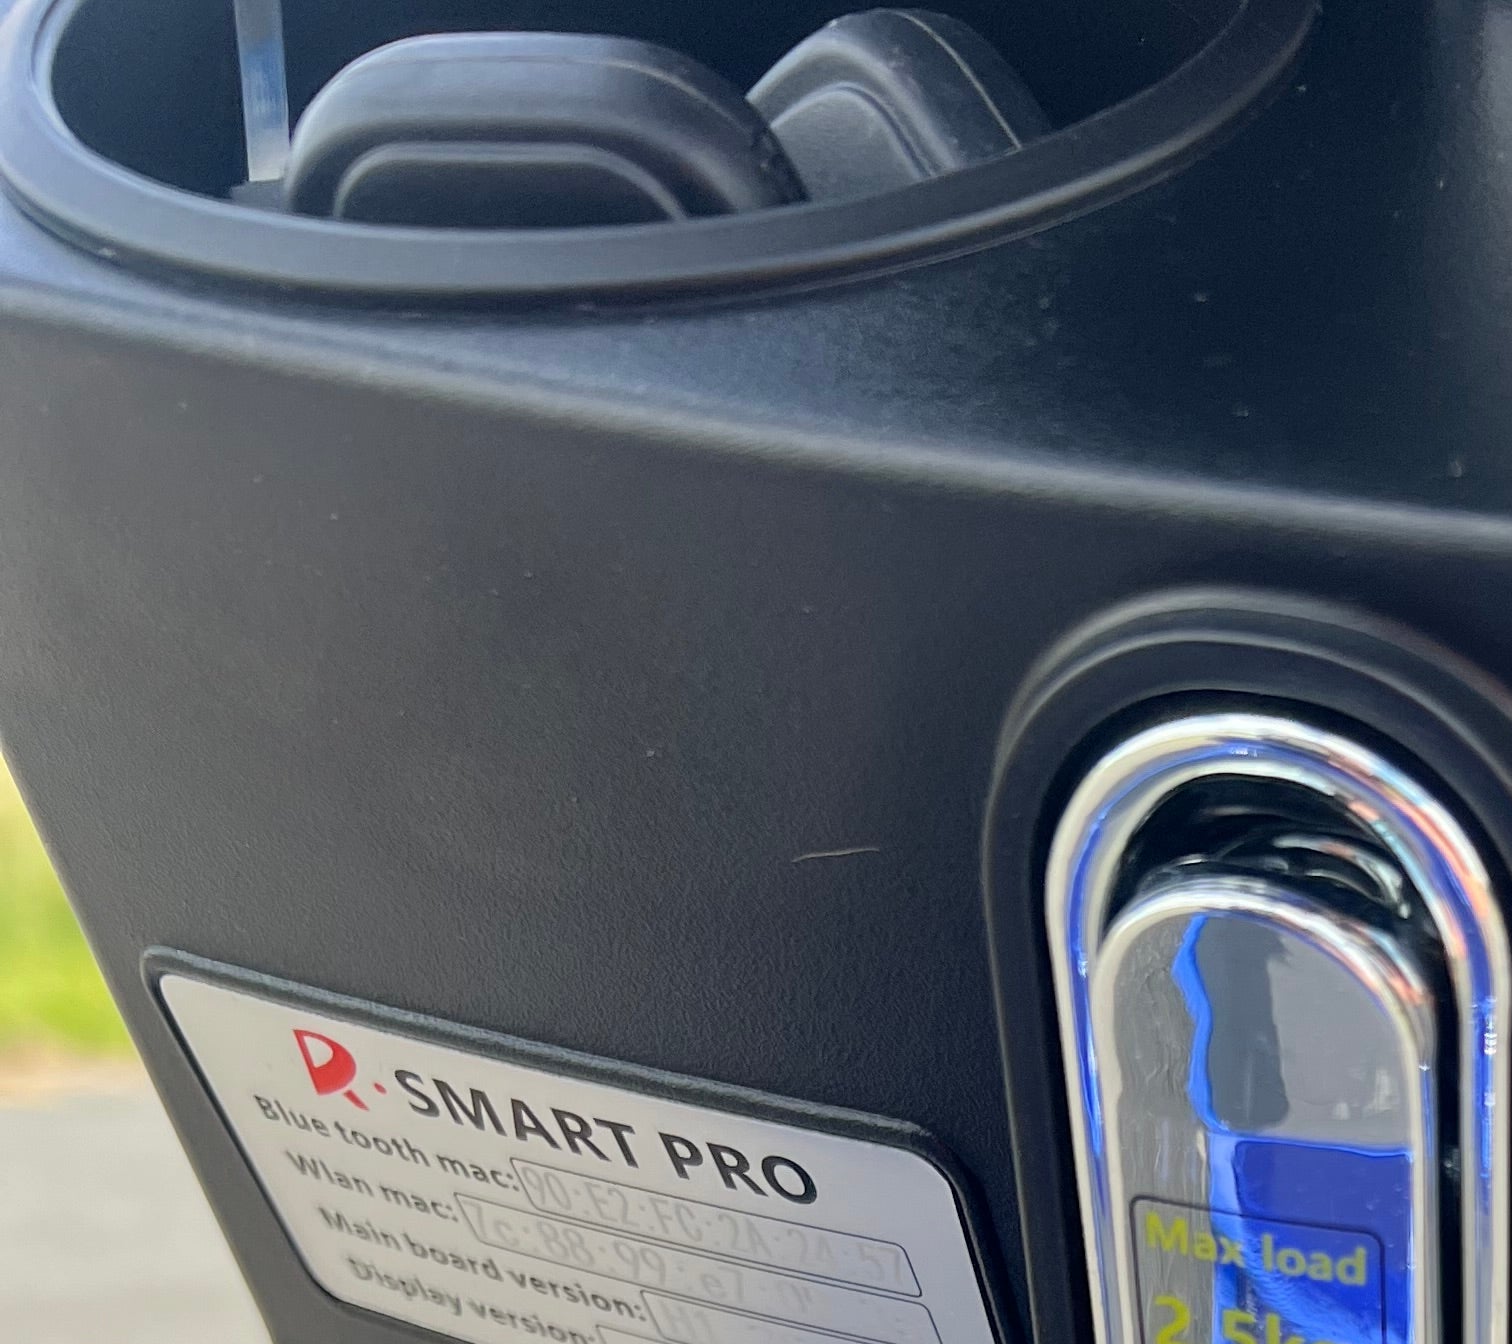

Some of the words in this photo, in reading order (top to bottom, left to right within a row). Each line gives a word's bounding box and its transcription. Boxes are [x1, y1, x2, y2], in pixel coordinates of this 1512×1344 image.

[254, 1094, 330, 1137] Blue
[336, 1121, 431, 1168] tooth
[436, 1152, 520, 1192] mac:
[394, 1069, 641, 1169] SMART
[660, 1131, 819, 1205] PRO
[285, 1149, 373, 1197] Wlan
[379, 1182, 459, 1222] mac:
[318, 1206, 398, 1249] Main
[408, 1231, 501, 1282] board
[508, 1268, 648, 1322] version:
[347, 1256, 462, 1316] Display
[1143, 1210, 1245, 1269] Max
[1262, 1234, 1367, 1285] load
